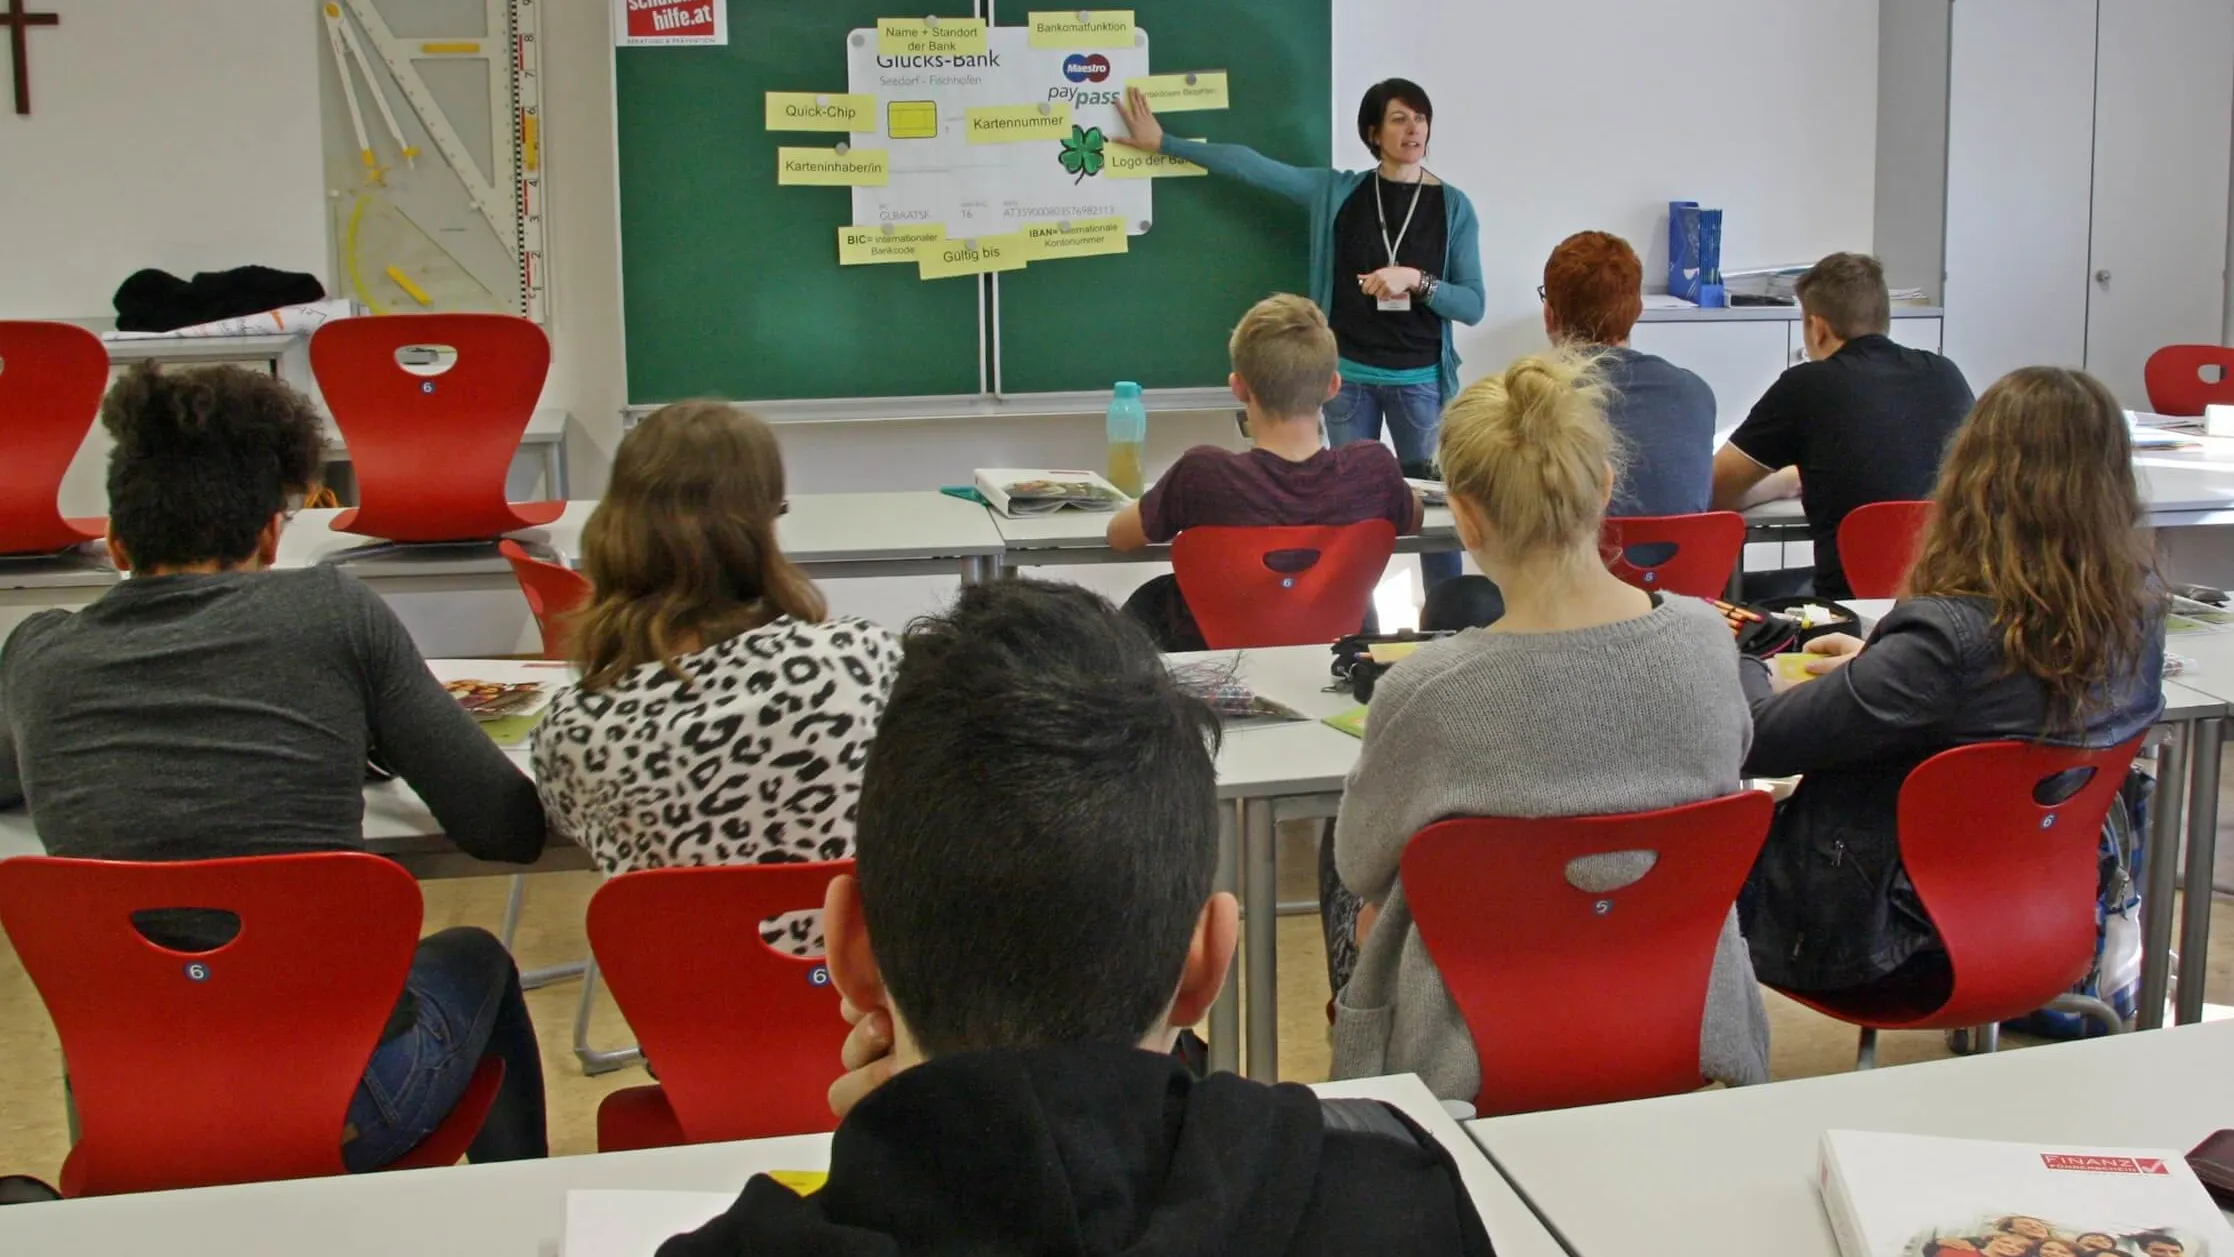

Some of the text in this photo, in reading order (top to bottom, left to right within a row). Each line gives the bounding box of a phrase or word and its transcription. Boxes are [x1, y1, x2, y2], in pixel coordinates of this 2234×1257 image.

[652, 5, 712, 31] hilfe.at
[886, 27, 918, 37] Name
[933, 27, 978, 37] Standort
[1036, 22, 1127, 34] Bankomatfunktion
[907, 41, 957, 51] der Bank
[1067, 64, 1107, 73] Maestro
[880, 75, 920, 86] Seedorf
[1048, 86, 1079, 101] pay
[1075, 91, 1121, 109] pass
[785, 105, 856, 120] Quick-Chip
[973, 116, 1064, 130] Kartennummer
[785, 162, 882, 173] Karteninhaber/in
[1112, 156, 1142, 169] Logo
[1145, 155, 1164, 165] der
[943, 247, 1001, 263] Gültig bis
[423, 382, 432, 393] 6
[2043, 814, 2055, 828] 6
[190, 964, 204, 979] 6
[813, 968, 827, 984] 6
[2045, 1154, 2135, 1167] FINANZ
